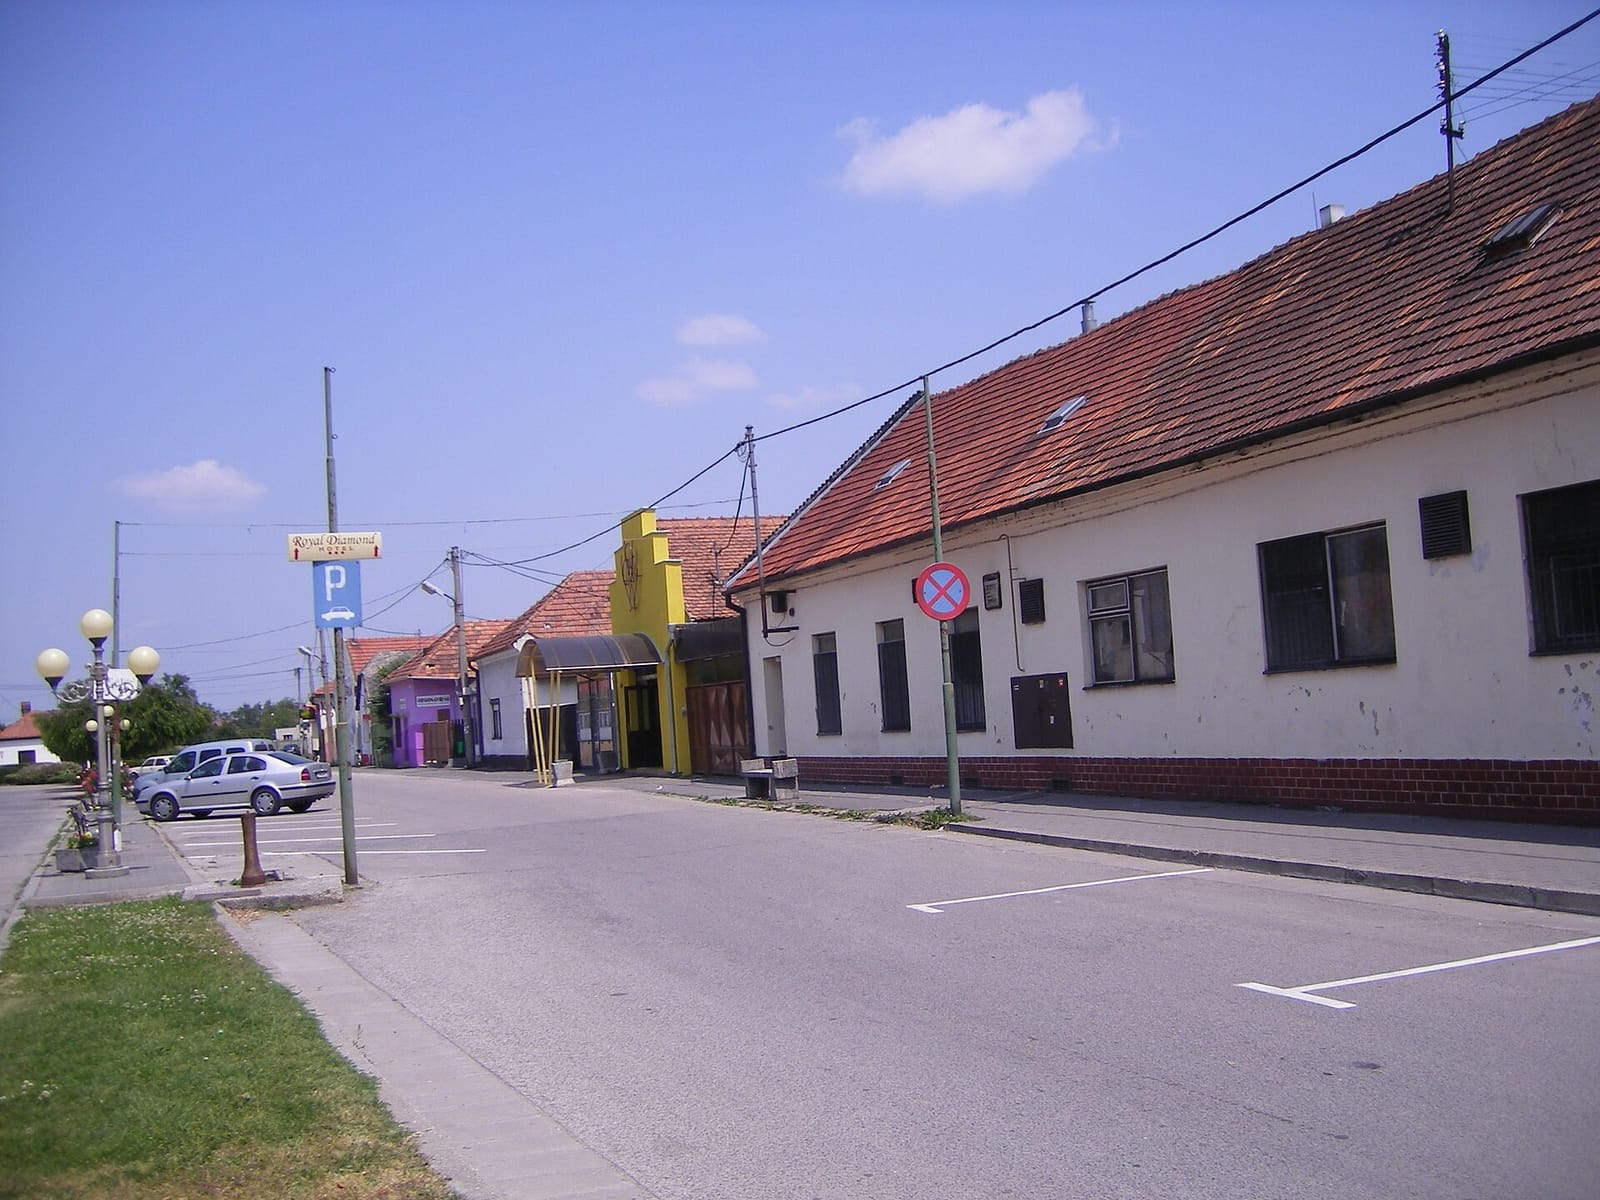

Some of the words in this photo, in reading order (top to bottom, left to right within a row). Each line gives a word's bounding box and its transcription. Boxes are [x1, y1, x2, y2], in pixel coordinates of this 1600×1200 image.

[292, 534, 326, 549] Royal
[326, 533, 377, 545] Diamond
[324, 565, 346, 601] P
